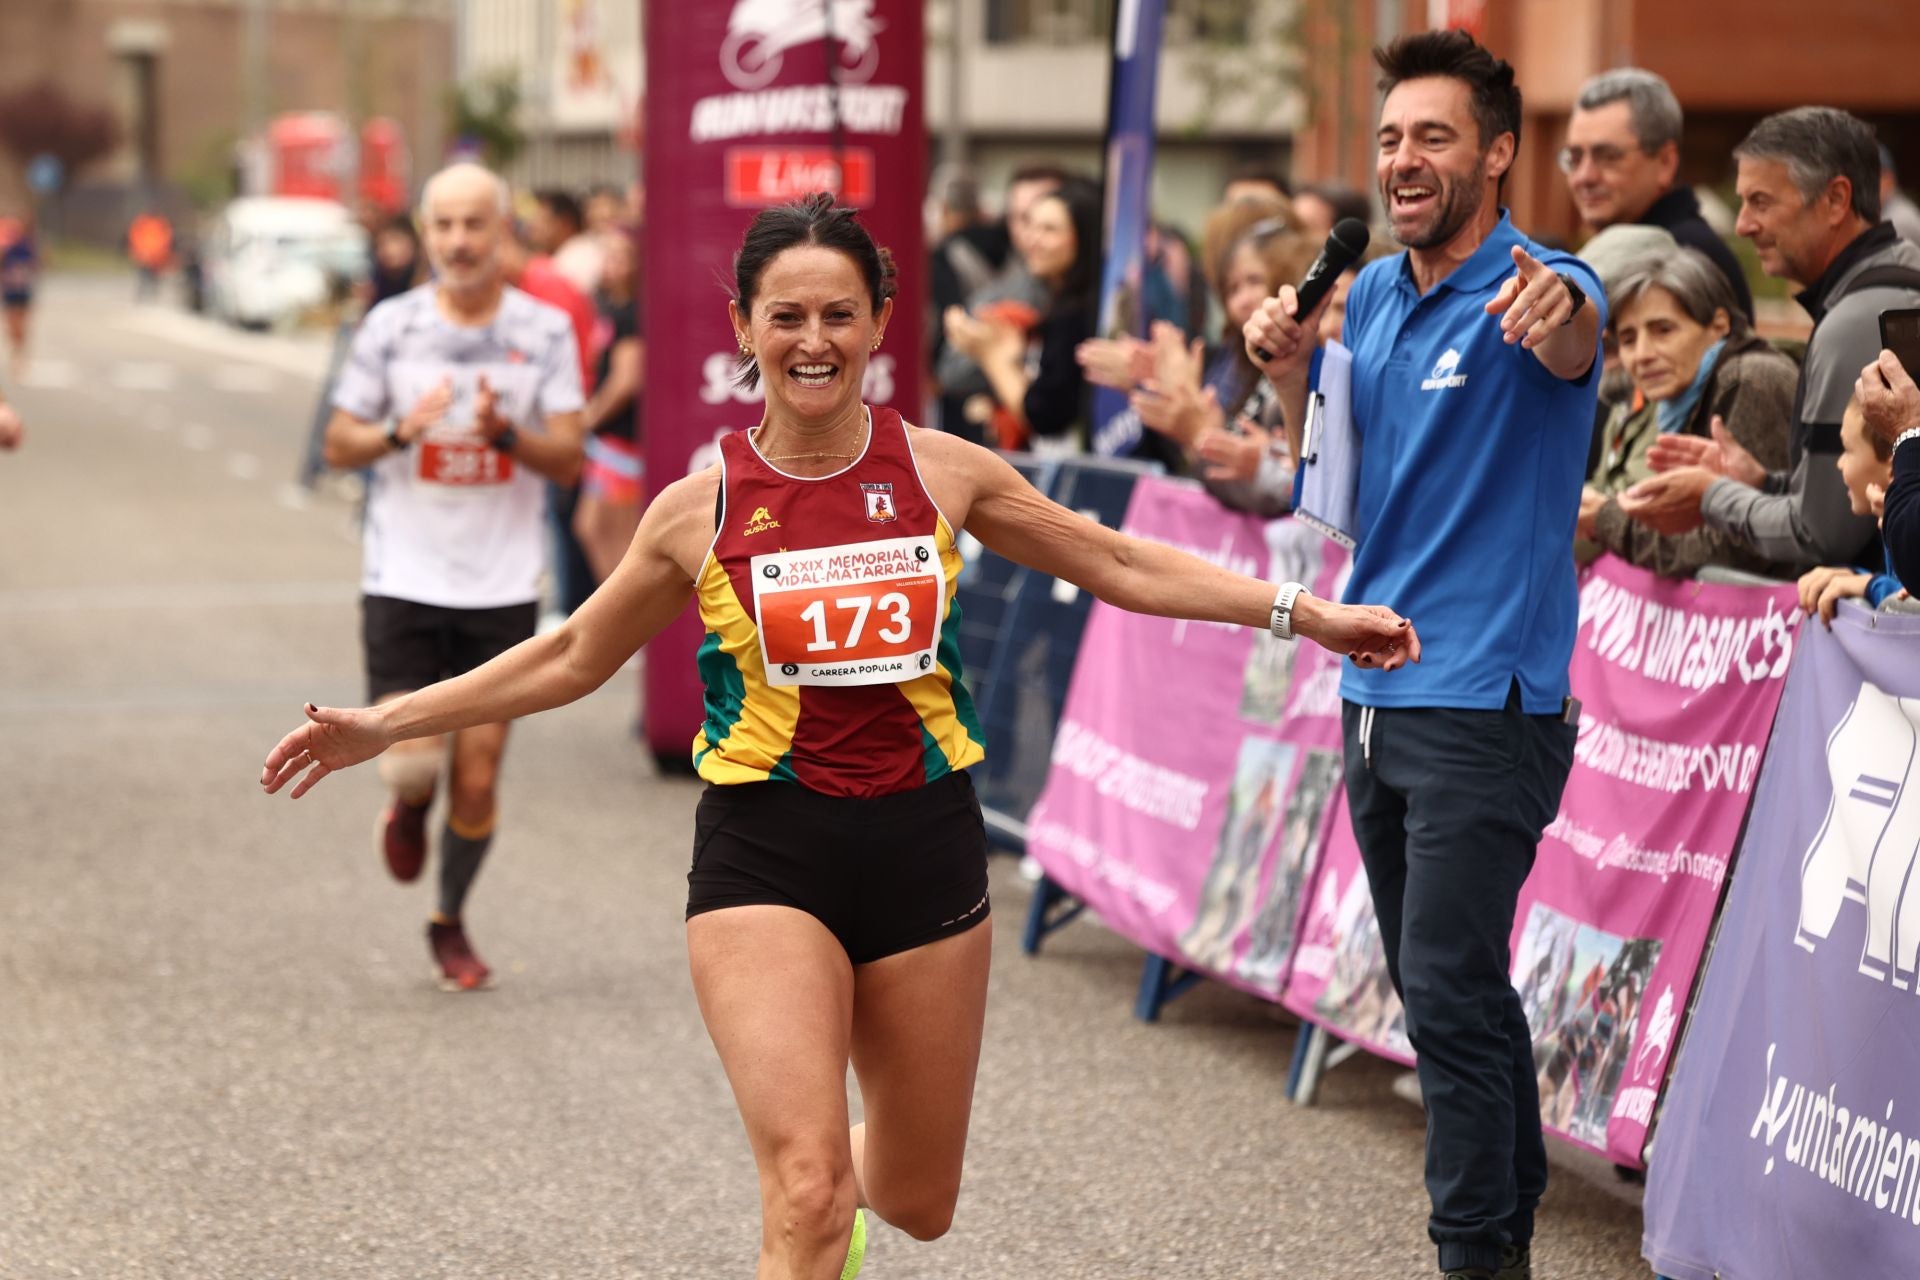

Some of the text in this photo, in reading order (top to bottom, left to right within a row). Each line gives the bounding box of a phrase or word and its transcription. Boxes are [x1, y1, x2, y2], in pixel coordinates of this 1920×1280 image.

[775, 560, 922, 588] VIDAL-MATARRANZ
[789, 548, 908, 574] XXIX MEMORIAL
[799, 592, 912, 652] 173
[811, 662, 903, 677] CARRERA POPULAR
